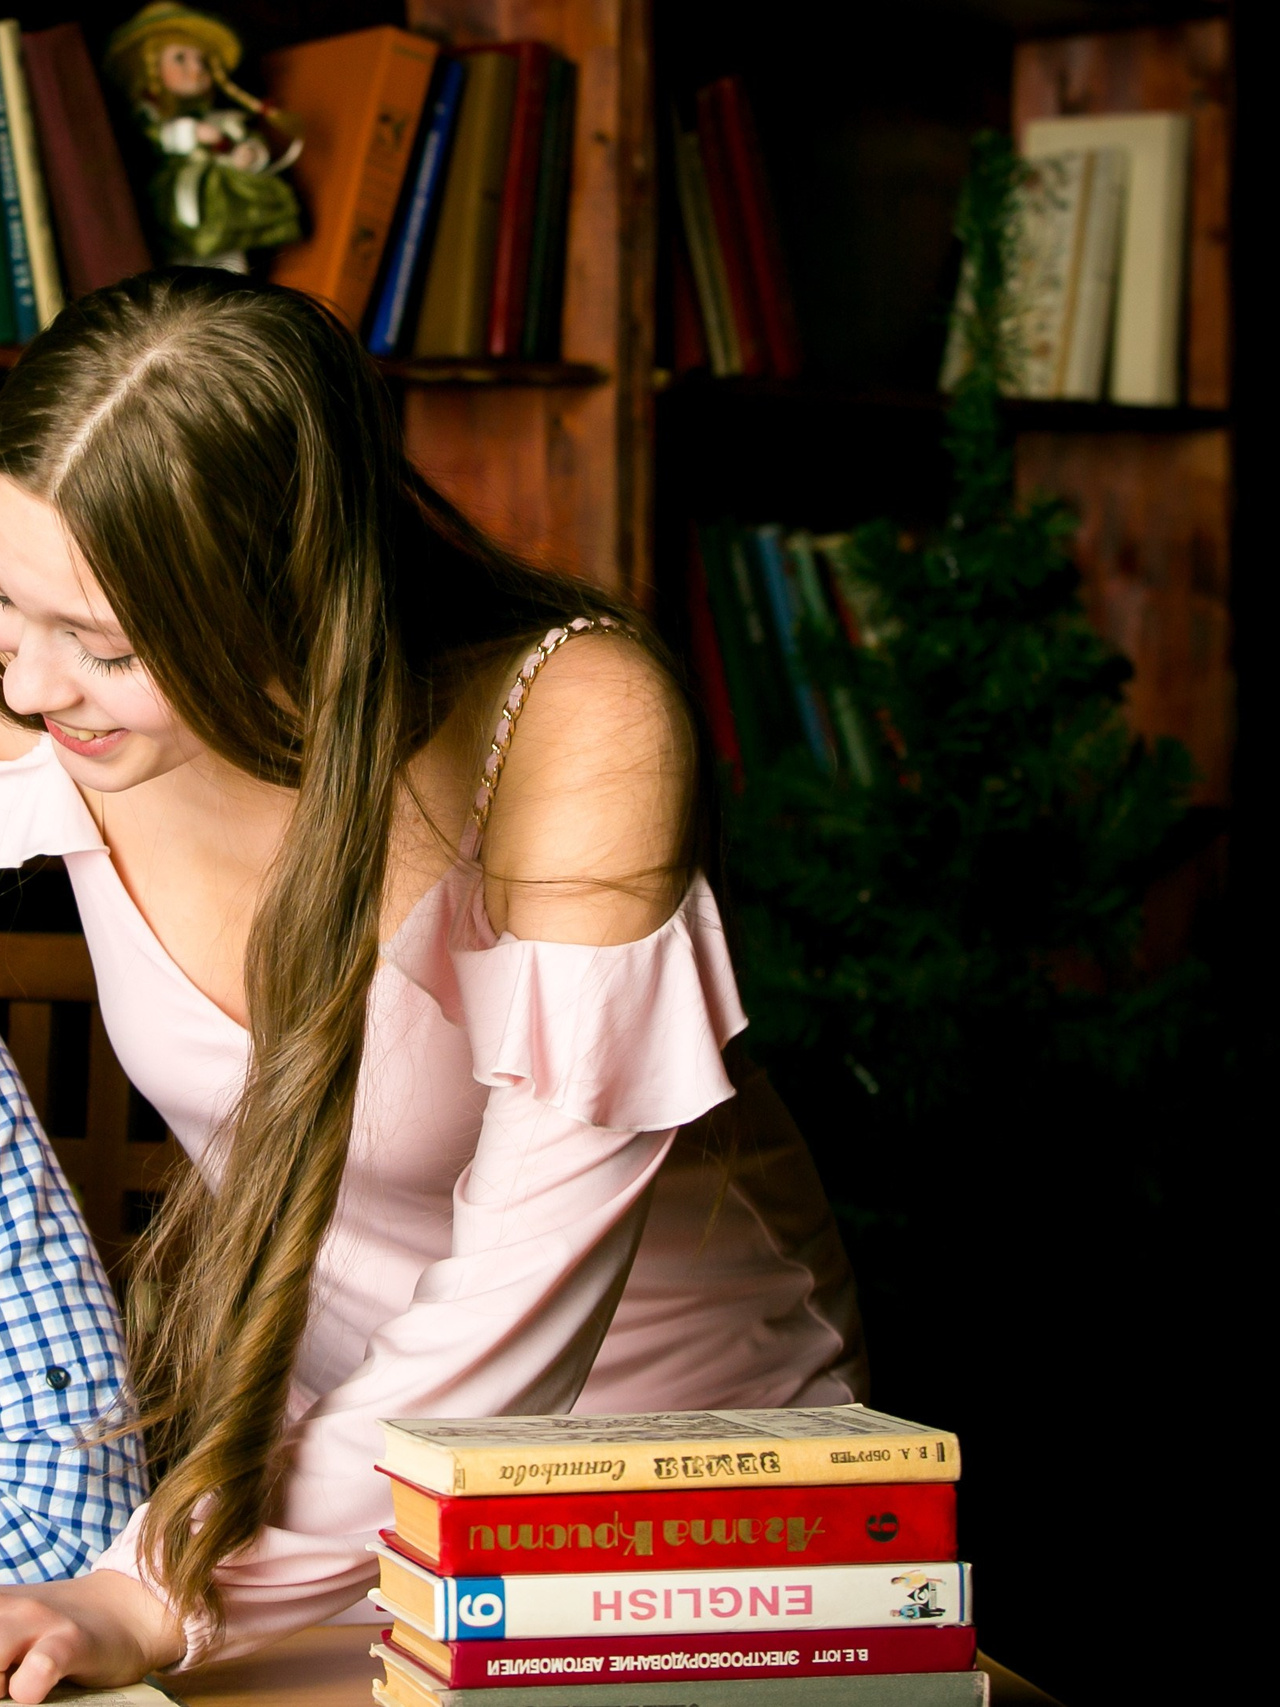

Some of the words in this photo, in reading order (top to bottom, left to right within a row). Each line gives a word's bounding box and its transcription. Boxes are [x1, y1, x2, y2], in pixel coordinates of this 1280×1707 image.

[653, 1450, 781, 1480] ЗЕМЛЯ
[830, 1449, 891, 1464] ОБРУЧЕВ
[500, 1460, 626, 1486] Санникова
[470, 1510, 654, 1557] Кристи
[662, 1517, 826, 1552] Агата
[592, 1584, 814, 1622] ENGLISH
[486, 1656, 604, 1676] АВТОМОБИЛЕЙ
[608, 1649, 800, 1672] ЭЛЕКТРООБОРУДОВАНИЕ
